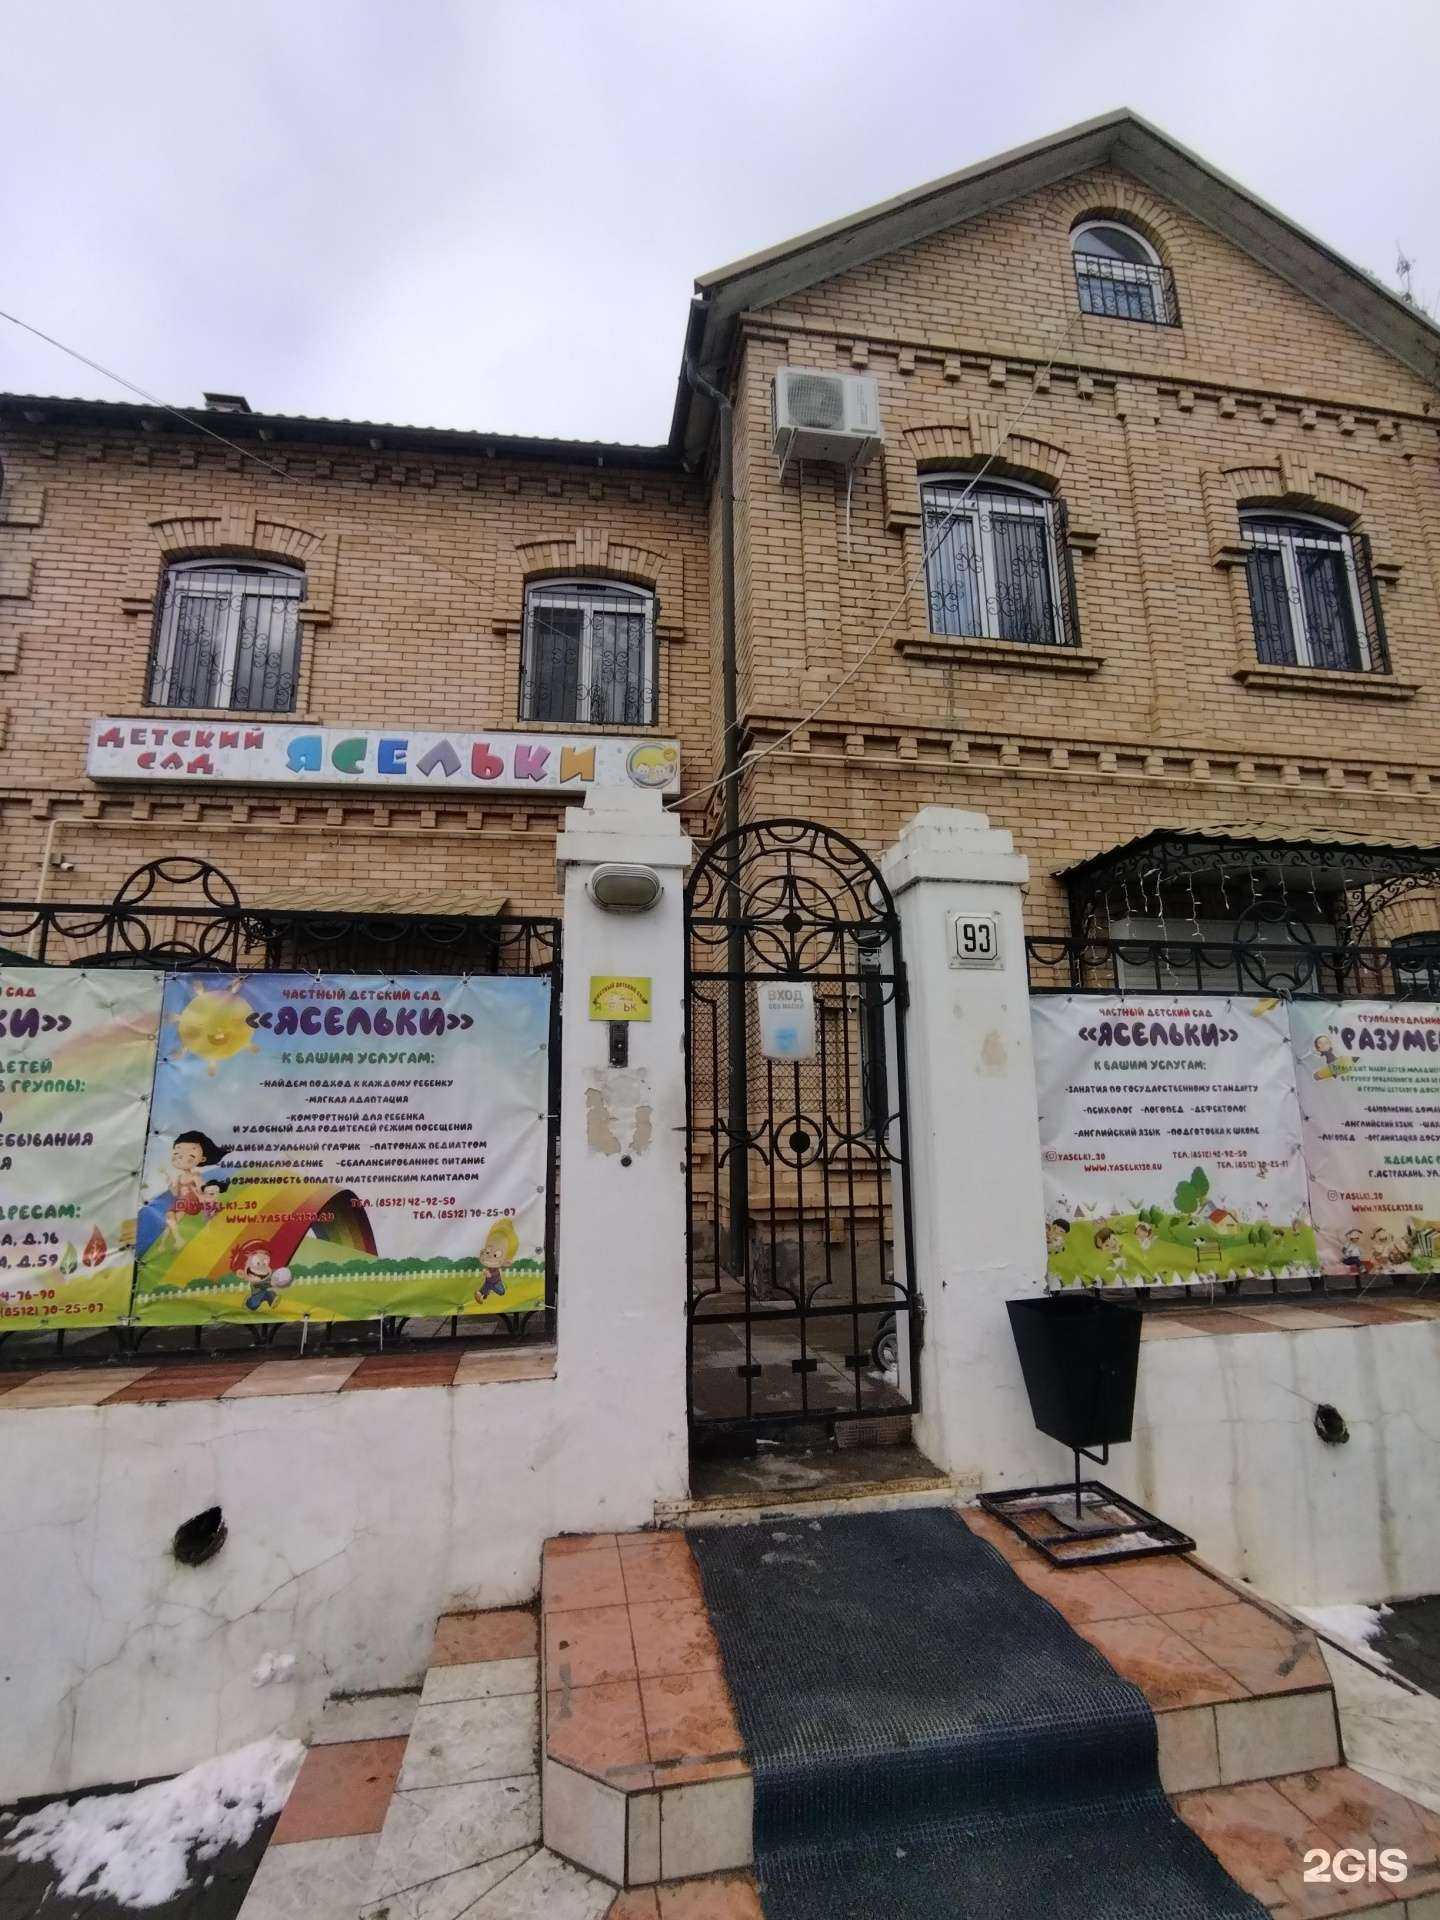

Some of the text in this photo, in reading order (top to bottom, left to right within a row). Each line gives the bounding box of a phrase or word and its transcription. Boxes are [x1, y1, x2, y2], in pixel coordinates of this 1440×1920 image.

[97, 726, 598, 784] ДЕТСКИЙ ЯСЕЛЬКИ
[137, 751, 214, 775] САД
[963, 923, 991, 952] 93
[5, 986, 37, 998] САД
[282, 988, 441, 1001] ЧАСТНЫЙ ДЕТСКИЙ САД
[768, 989, 804, 1002] ВХОД
[1099, 1007, 1213, 1018] ЧАСТНЫЙ ДЕТСКИЙ САД
[245, 1006, 474, 1036] «ЯСЕЛЬКИ»
[1078, 1022, 1238, 1047] «ЯСЕЛЬКИ»
[282, 1052, 435, 1065] К ВАШИМ УСЛУГАМ:
[1094, 1059, 1206, 1071] К ВАШИМ УСЛУГАМ:
[11, 1078, 86, 1093] ГРУППЫ:
[260, 1078, 453, 1088] -НАЙДЕМ ПОДХОД К КАЖДОМУ РЕБЕНКУ
[1065, 1084, 1258, 1093] -ЗАНЯТИЯ ПО ГОСУДАРСТВЕННОМУ СТАНДАРТУ
[305, 1095, 409, 1104] -МЯГКАЯ АДАПТАЦИЯ
[1083, 1106, 1133, 1114] -ПСИХОЛОГ
[1140, 1105, 1183, 1113] -ЛОГОПЕД
[1190, 1105, 1247, 1113] -ДЕФЕКТОЛОГ
[286, 1112, 425, 1121] -КОМФОРТНЫЙ ДЛЯ РЕБЕНКА
[233, 1123, 473, 1133] И УДОБНЫЙ ДЛЯ РОДИТЕЛЕЙ РЕЖИМ ПОСЕЩЕНИЯ
[1074, 1127, 1160, 1137] -АНГЛИЙСКИЙ ЯЗЫК
[1167, 1126, 1260, 1136] -ПОДГОТОВКА К ШКОЛЕ
[321, 1143, 361, 1151] ГРАФИК
[370, 1141, 488, 1150] -ПАТРОНАЖ ПЕДИАТРОМ
[1172, 1151, 1189, 1159] ТЕЛ.
[1384, 1155, 1413, 1165] ЖДЕМ
[1415, 1155, 1434, 1165] ВАС
[336, 1157, 486, 1167] -СБАЛАНСИРОВАННОЕ ПИТАНИЕ
[1216, 1161, 1233, 1169] ТЕЛ.
[303, 1176, 343, 1184] ОПЛАТЫ
[345, 1175, 418, 1183] МАТЕРИНСКИМ
[420, 1173, 479, 1182] КАПИТАЛОМ
[351, 1196, 456, 1208] ТЕЛ. (8512) 42-92-50
[413, 1208, 516, 1219] ТЕЛ. (8512) 70-25-07
[22, 1231, 59, 1245] Д.16
[16, 1253, 59, 1268] Д.59
[43, 1302, 104, 1316] 70-25-07
